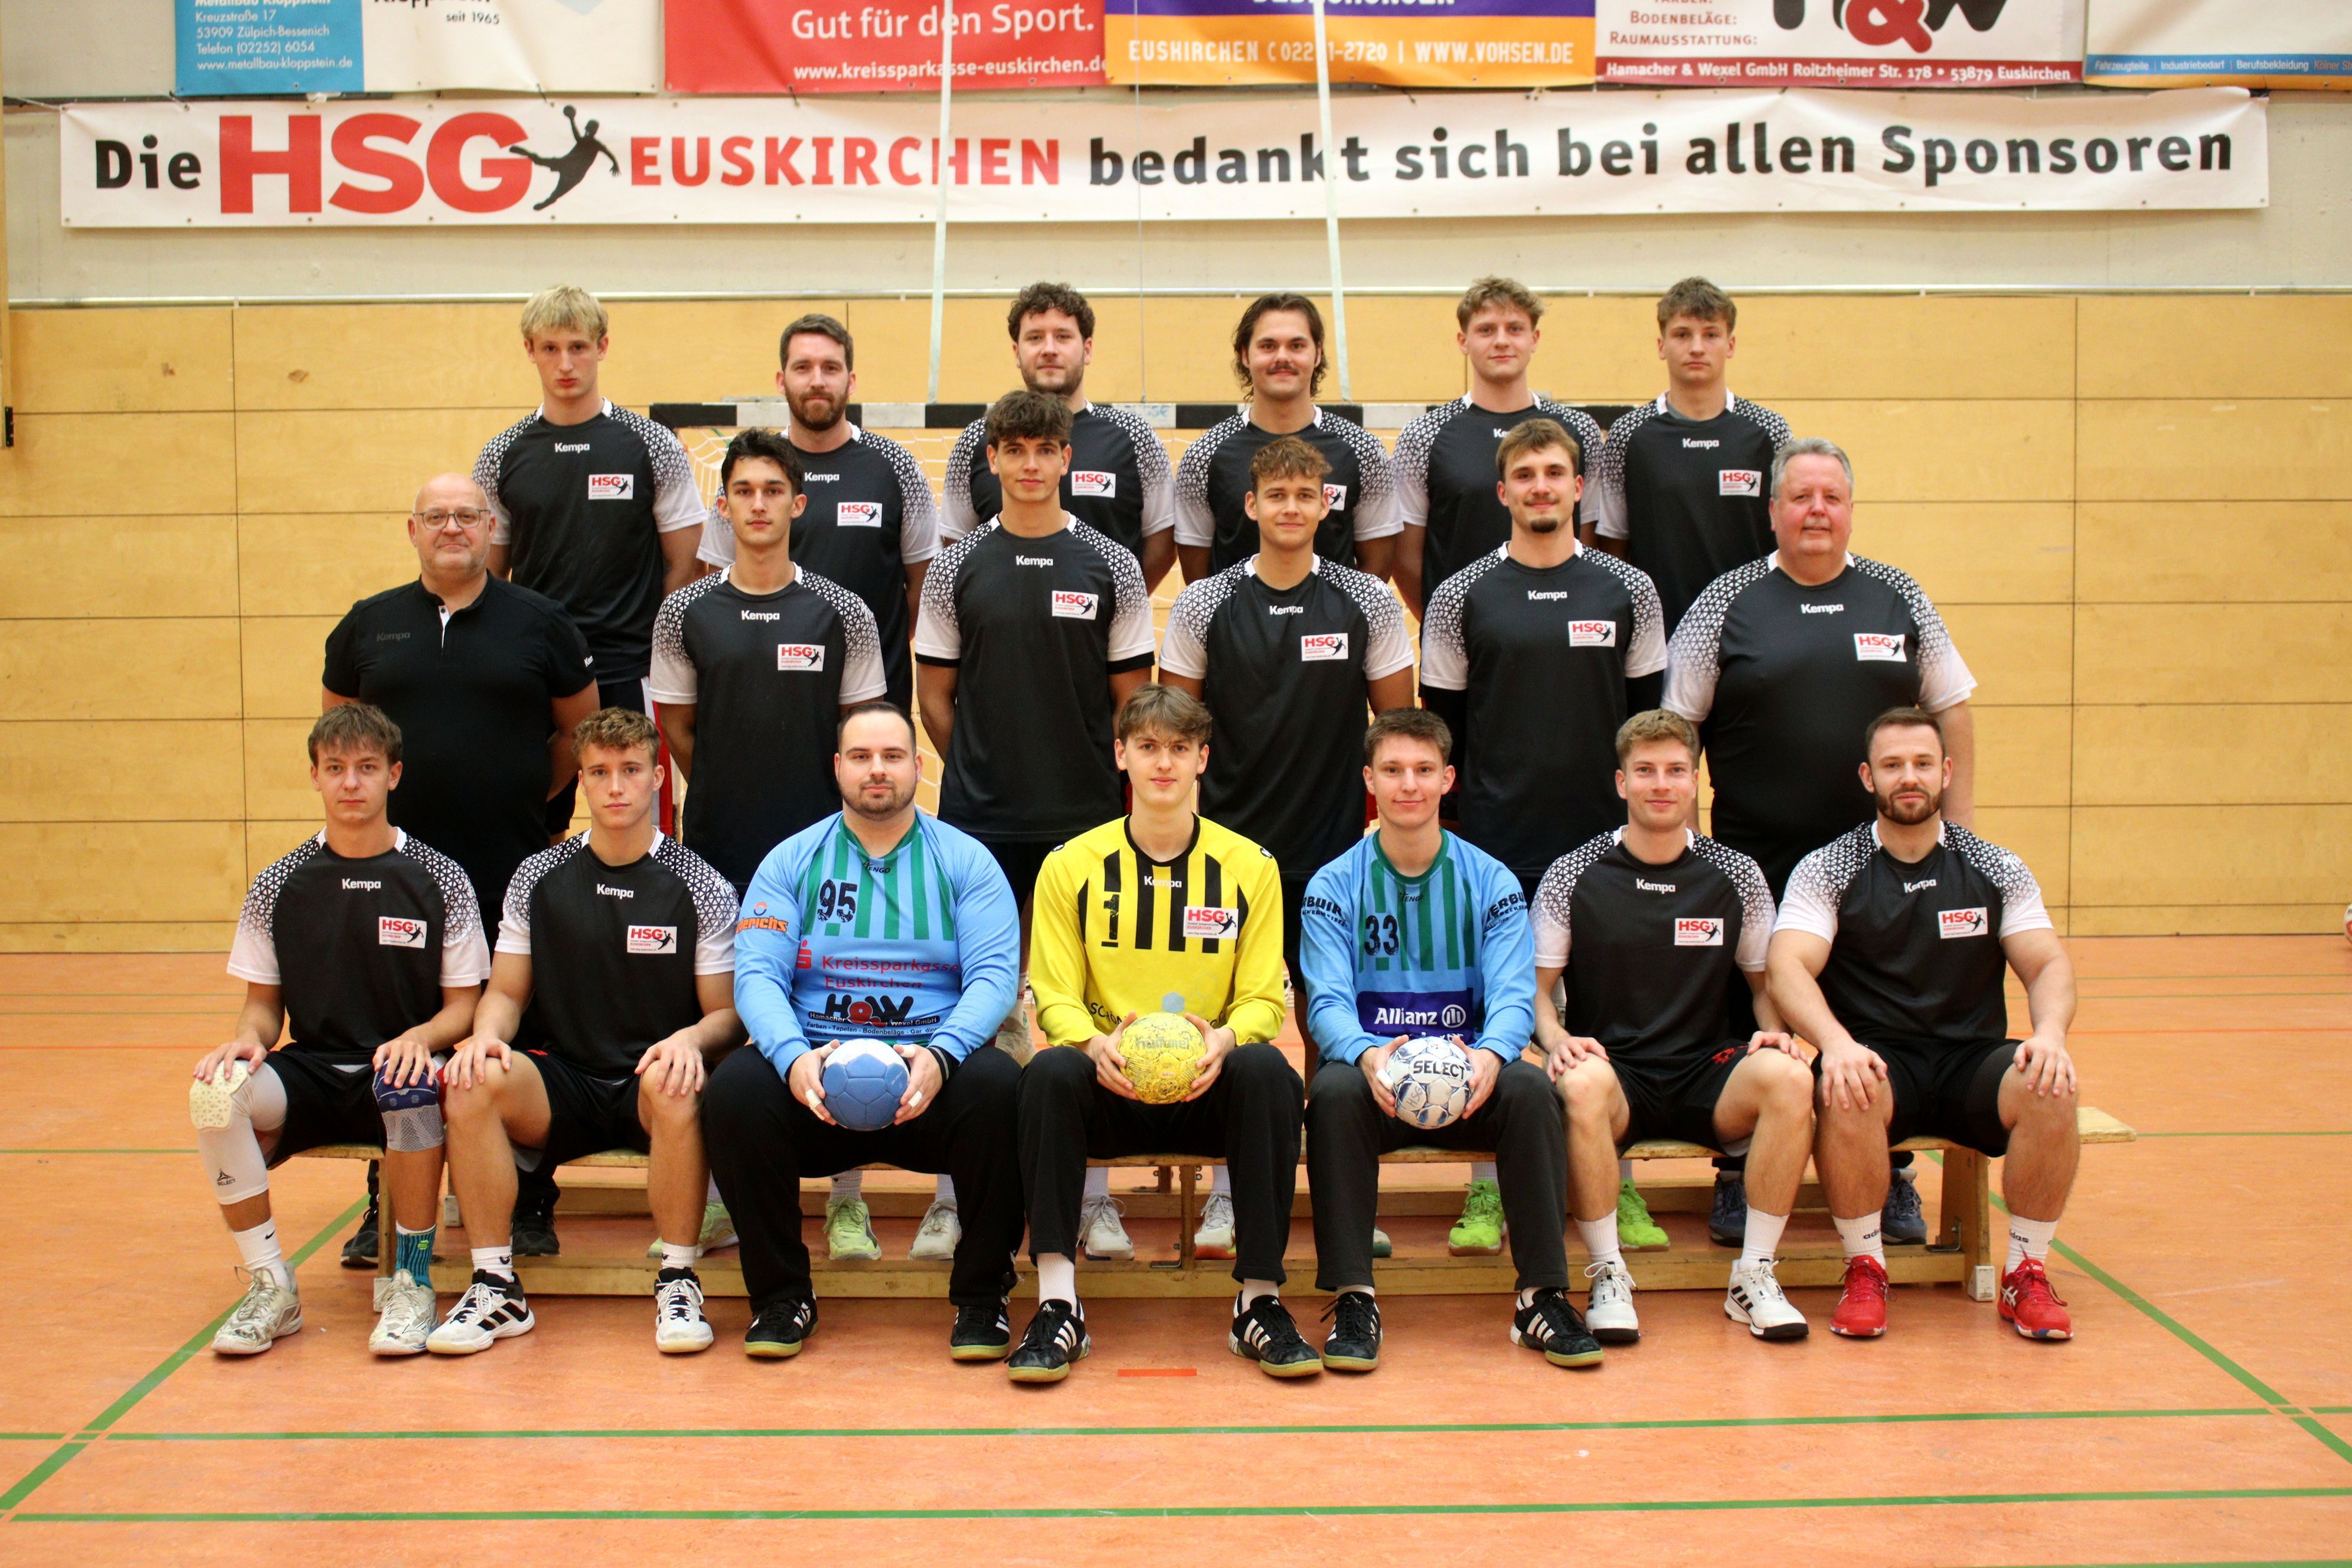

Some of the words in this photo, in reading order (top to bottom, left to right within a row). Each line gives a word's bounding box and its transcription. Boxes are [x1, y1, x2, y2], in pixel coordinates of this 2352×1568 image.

[195, 9, 258, 22] Kreuzstraße
[263, 9, 276, 21] 17
[446, 11, 465, 22] seit
[472, 12, 499, 24] 1965
[792, 9, 852, 39] Gut
[860, 7, 909, 37] für
[918, 5, 981, 37] den
[992, 4, 1094, 40] Sport.
[1631, 11, 1737, 25] BODENBELÄGE:
[197, 27, 234, 39] 53909
[237, 24, 329, 39] Zülpich-Bessenich
[1610, 31, 1758, 45] RAUMAUSSTATTUNG:
[197, 42, 233, 54] Telefon
[237, 41, 281, 55] (02252)
[285, 41, 315, 53] 6054
[1129, 40, 1258, 61] EUSKIRCHEN
[1280, 41, 1387, 61] 0221-2720
[1415, 41, 1573, 63] WWW.VOHSEN.DE
[197, 55, 353, 70] www.metallbau-kloppstein.de
[2095, 60, 2149, 72] Fahrzeugteile
[2161, 60, 2224, 70] Industriebedarf
[2237, 60, 2309, 72] Berufsbekleidung
[1606, 63, 1675, 76] Hamacher
[1681, 63, 1694, 76] &
[1698, 63, 1741, 77] Wexel
[1745, 63, 1788, 76] GmbH
[1794, 63, 1874, 78] Roitzheimer
[1879, 64, 1902, 78] Str.
[1908, 65, 1932, 79] 178
[1951, 66, 1992, 81] 53879
[1998, 67, 2070, 81] Euskirchen
[96, 134, 201, 189] Die
[219, 112, 532, 214] HSG
[631, 136, 1060, 187] EUSKIRCHEN
[1089, 134, 1369, 185] bedankt
[1395, 127, 1529, 181] sich
[1557, 123, 1657, 177] bei
[1685, 122, 1855, 175] allen
[1882, 125, 2232, 186] Sponsoren
[555, 442, 590, 453] Kempa
[1683, 438, 1719, 449] Kempa
[592, 476, 621, 486] HSG
[804, 472, 840, 483] Kempa
[1075, 473, 1104, 484] HSG
[1723, 472, 1751, 482] HSG
[841, 504, 870, 514] HSG
[1015, 555, 1054, 568] Kempa
[1056, 593, 1086, 605] HSG
[1528, 590, 1567, 601] Kempa
[1269, 605, 1304, 615] Kempa
[1801, 603, 1844, 614] Kempa
[741, 610, 780, 622] Kempa
[1573, 623, 1604, 633] HSG
[377, 632, 411, 641] Kempa
[1305, 636, 1335, 647] HSG
[1860, 636, 1892, 648] HSG
[782, 646, 813, 657] HSG
[342, 878, 381, 891] Kempa
[1144, 876, 1182, 888] Kempa
[1636, 878, 1676, 894] Kempa
[1903, 878, 1936, 893] Kempa
[596, 883, 634, 899] Kempa
[818, 879, 857, 923] 95
[1188, 910, 1224, 923] HSG
[1942, 911, 1974, 924] HSG
[383, 919, 413, 932] HSG
[1678, 921, 1710, 932] HSG
[631, 928, 663, 940] HSG
[1365, 915, 1399, 956] 33
[822, 956, 959, 974] Kreissparkasse
[810, 1012, 845, 1023] Hamacher
[915, 1017, 937, 1025] GmbH
[1374, 1007, 1438, 1025] Allianz
[863, 1027, 904, 1036] Bodenbeläge
[1413, 1060, 1465, 1080] SELECT
[1406, 1087, 1422, 1108] HSG
